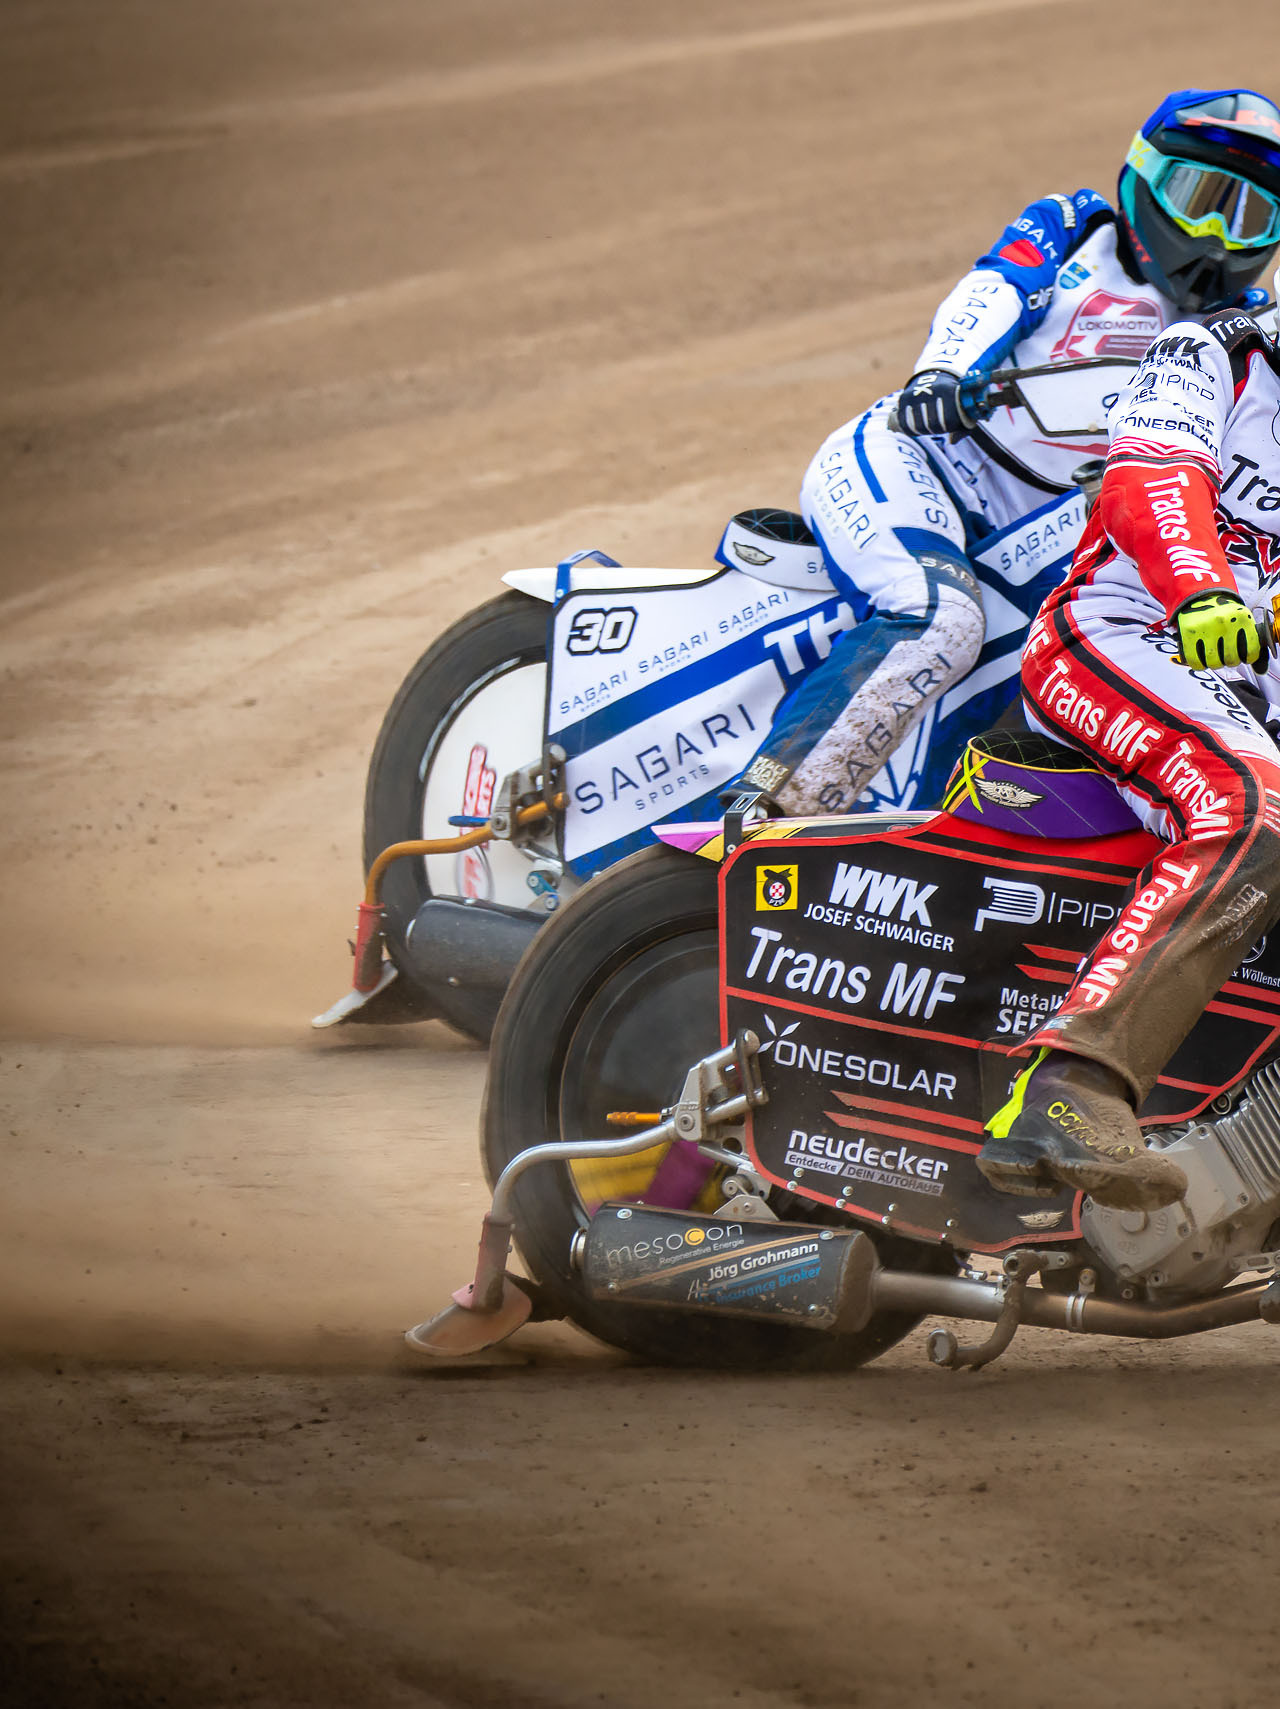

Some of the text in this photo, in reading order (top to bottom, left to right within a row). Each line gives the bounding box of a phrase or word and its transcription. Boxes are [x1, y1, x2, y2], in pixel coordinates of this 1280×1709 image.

[1078, 320, 1158, 332] LOKOMOTIV
[1000, 507, 1080, 571] SAGARI
[1144, 471, 1220, 585] Trans MF
[560, 591, 789, 714] SAGARI SAGARI SAGARI
[566, 606, 639, 656] 30
[819, 653, 953, 812] SAGARI
[1040, 659, 1162, 762] Trans MF
[574, 703, 755, 814] SAGARI
[635, 764, 710, 810] SPORTS
[1160, 741, 1215, 815] Trans
[829, 862, 939, 928] WWK
[804, 903, 955, 953] JOSEF SCHWAIGER
[1079, 862, 1198, 1008] Trans MF
[745, 926, 966, 1020] Trans MF
[774, 1039, 958, 1101] ONESOLAR
[788, 1129, 949, 1180] neudecker
[788, 1154, 941, 1195] Entdecke DEIN AUTOHAUS
[605, 1222, 744, 1268] mesocon
[659, 1239, 745, 1266] Regenerative Energie
[708, 1243, 818, 1281] Jörg Grohmann
[778, 1265, 822, 1287] Broker
